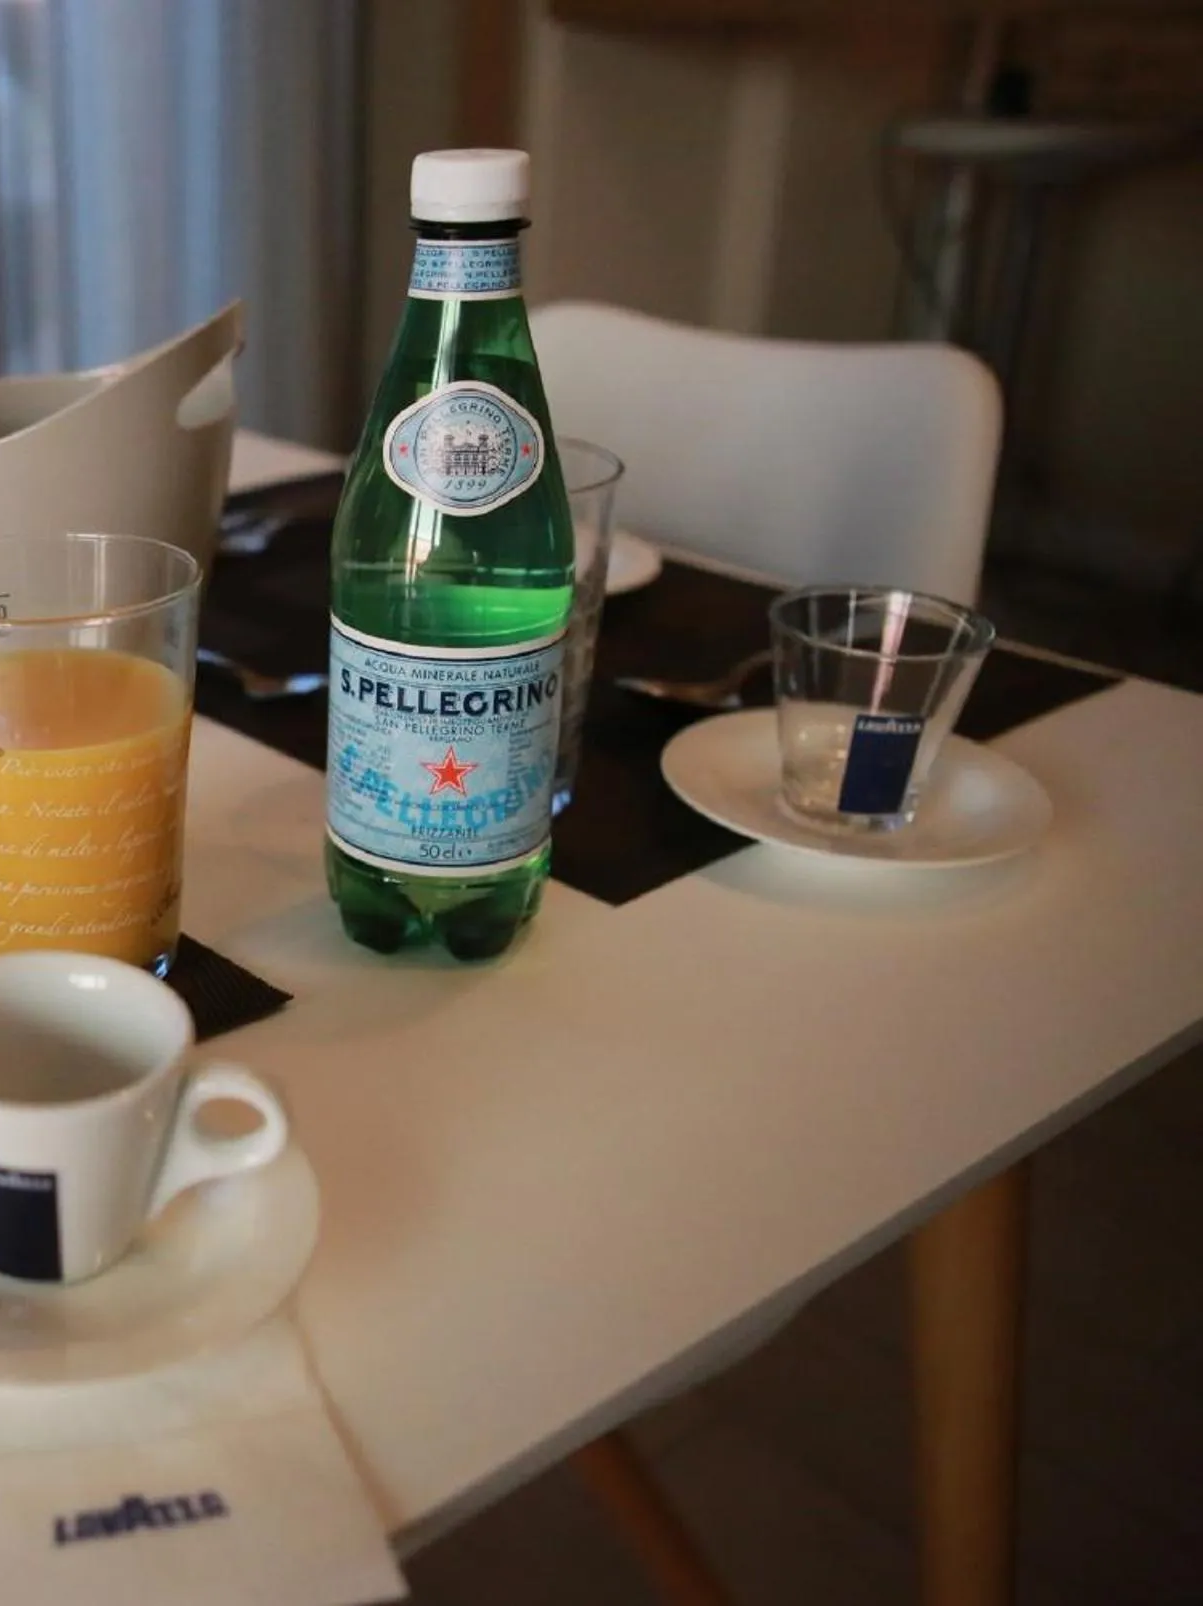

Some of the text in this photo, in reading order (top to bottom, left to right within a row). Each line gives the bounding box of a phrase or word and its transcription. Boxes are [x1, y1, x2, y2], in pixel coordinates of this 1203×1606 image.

[443, 478, 487, 491] 1899
[364, 658, 541, 682] ACQUA MINERALE NATURALE
[340, 668, 559, 717] S.PELLEGRINO
[404, 721, 486, 736] PELLEGRINO
